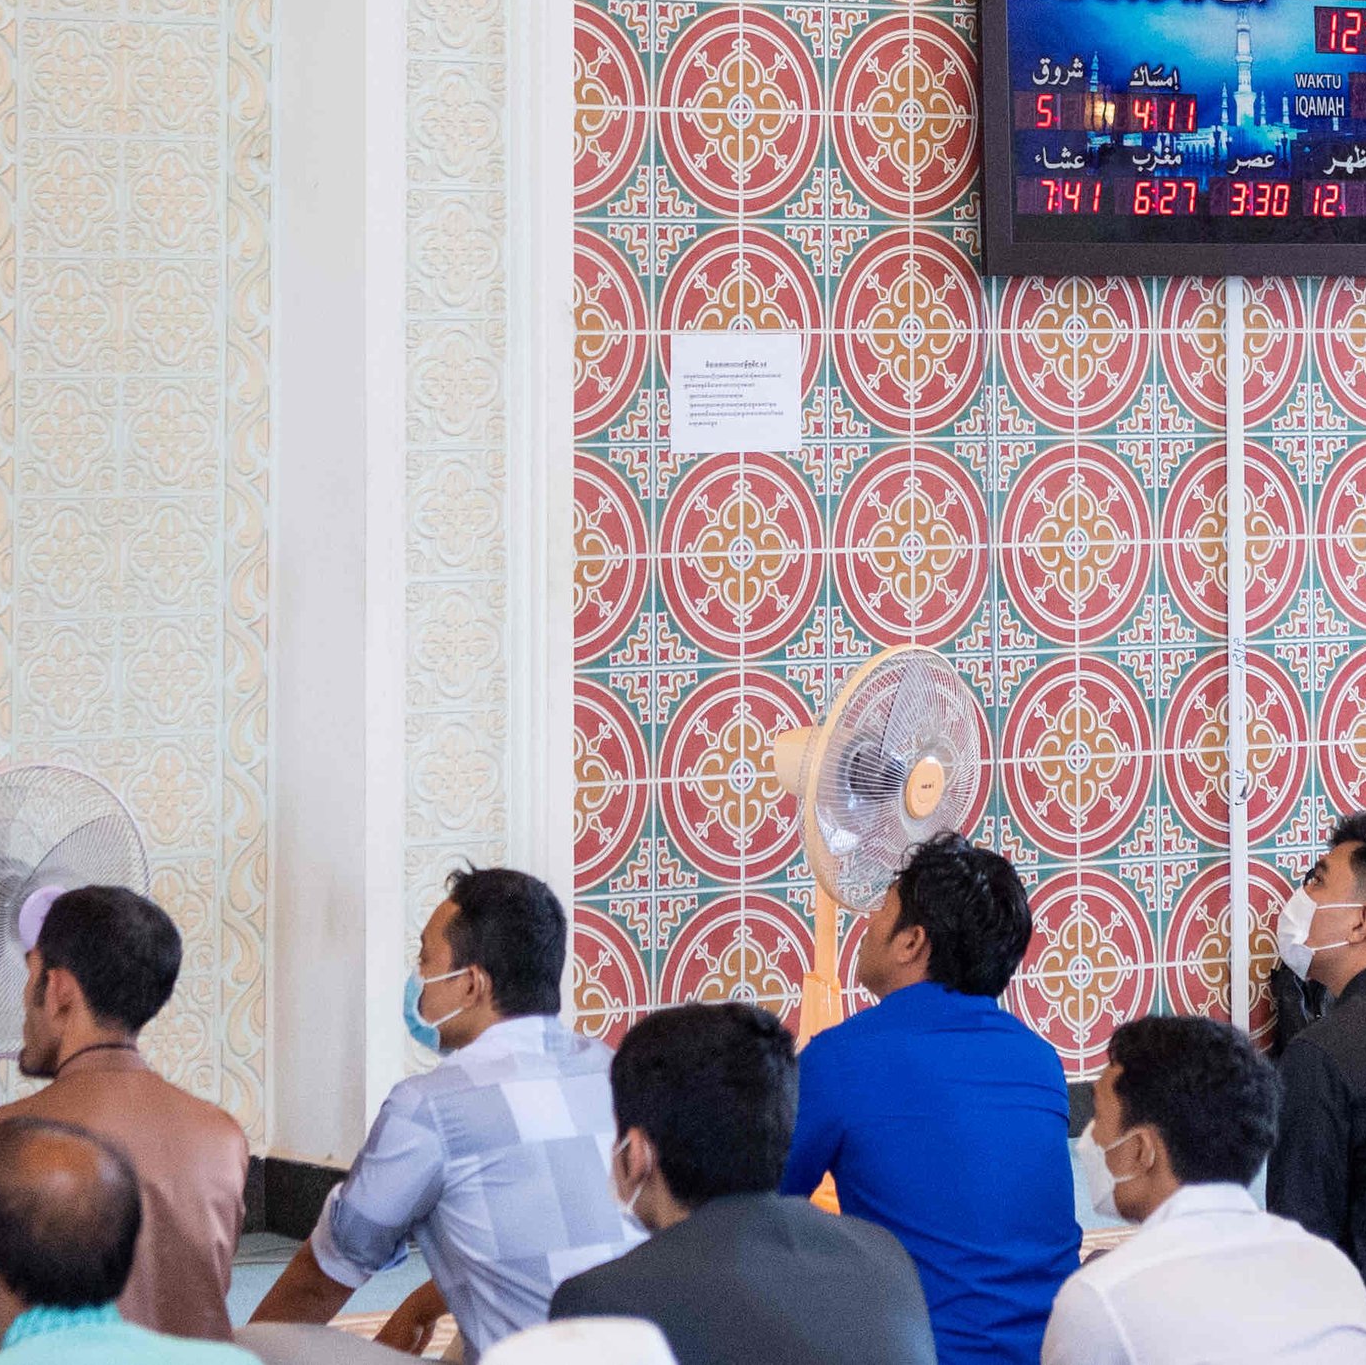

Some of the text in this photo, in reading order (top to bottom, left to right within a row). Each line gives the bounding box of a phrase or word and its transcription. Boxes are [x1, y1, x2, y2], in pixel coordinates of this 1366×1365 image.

[1032, 57, 1084, 86] شروق
[1294, 73, 1342, 90] WAKTU
[1132, 98, 1197, 133] 4:11
[1295, 95, 1346, 118] IQAMAH
[1034, 145, 1086, 170] عشاء
[1131, 146, 1183, 172] مغرب
[1227, 152, 1276, 175] عصر
[1039, 179, 1103, 214] 7:41
[1133, 181, 1199, 216] 6:27
[1229, 181, 1291, 217] 3:30
